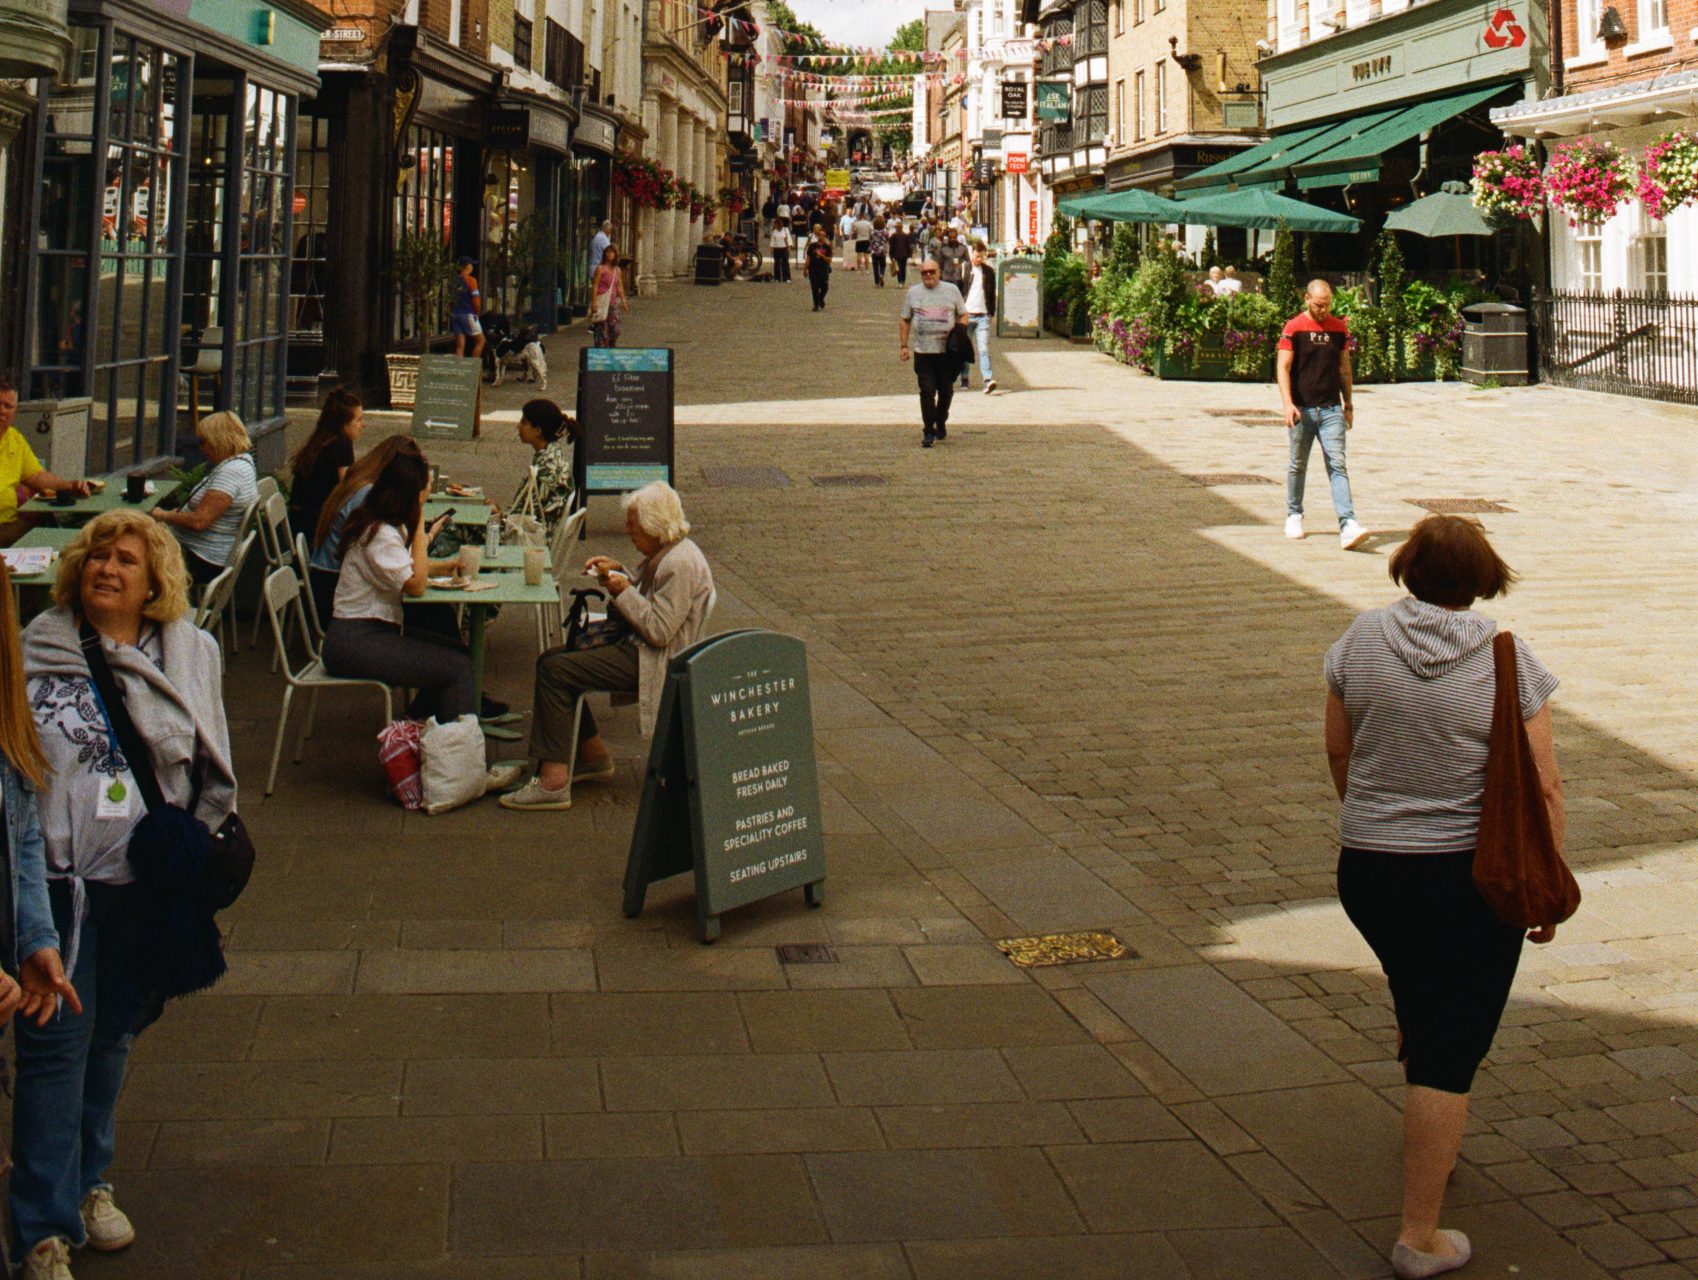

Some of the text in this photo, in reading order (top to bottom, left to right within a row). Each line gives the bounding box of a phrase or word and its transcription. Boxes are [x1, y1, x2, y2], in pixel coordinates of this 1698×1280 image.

[335, 30, 361, 39] STREET
[1040, 101, 1067, 109] ITALIAN
[747, 670, 757, 678] THE
[711, 678, 795, 705] WINCHESTER
[730, 701, 779, 722] BAKERY
[732, 760, 789, 784] BREAD BAKED
[737, 776, 787, 799] FRESH DAILY
[735, 805, 794, 831] PASTRIES AND
[724, 817, 808, 851] SPECIALITY COFFEE
[730, 849, 807, 883] SEATING UPSTAIRS
